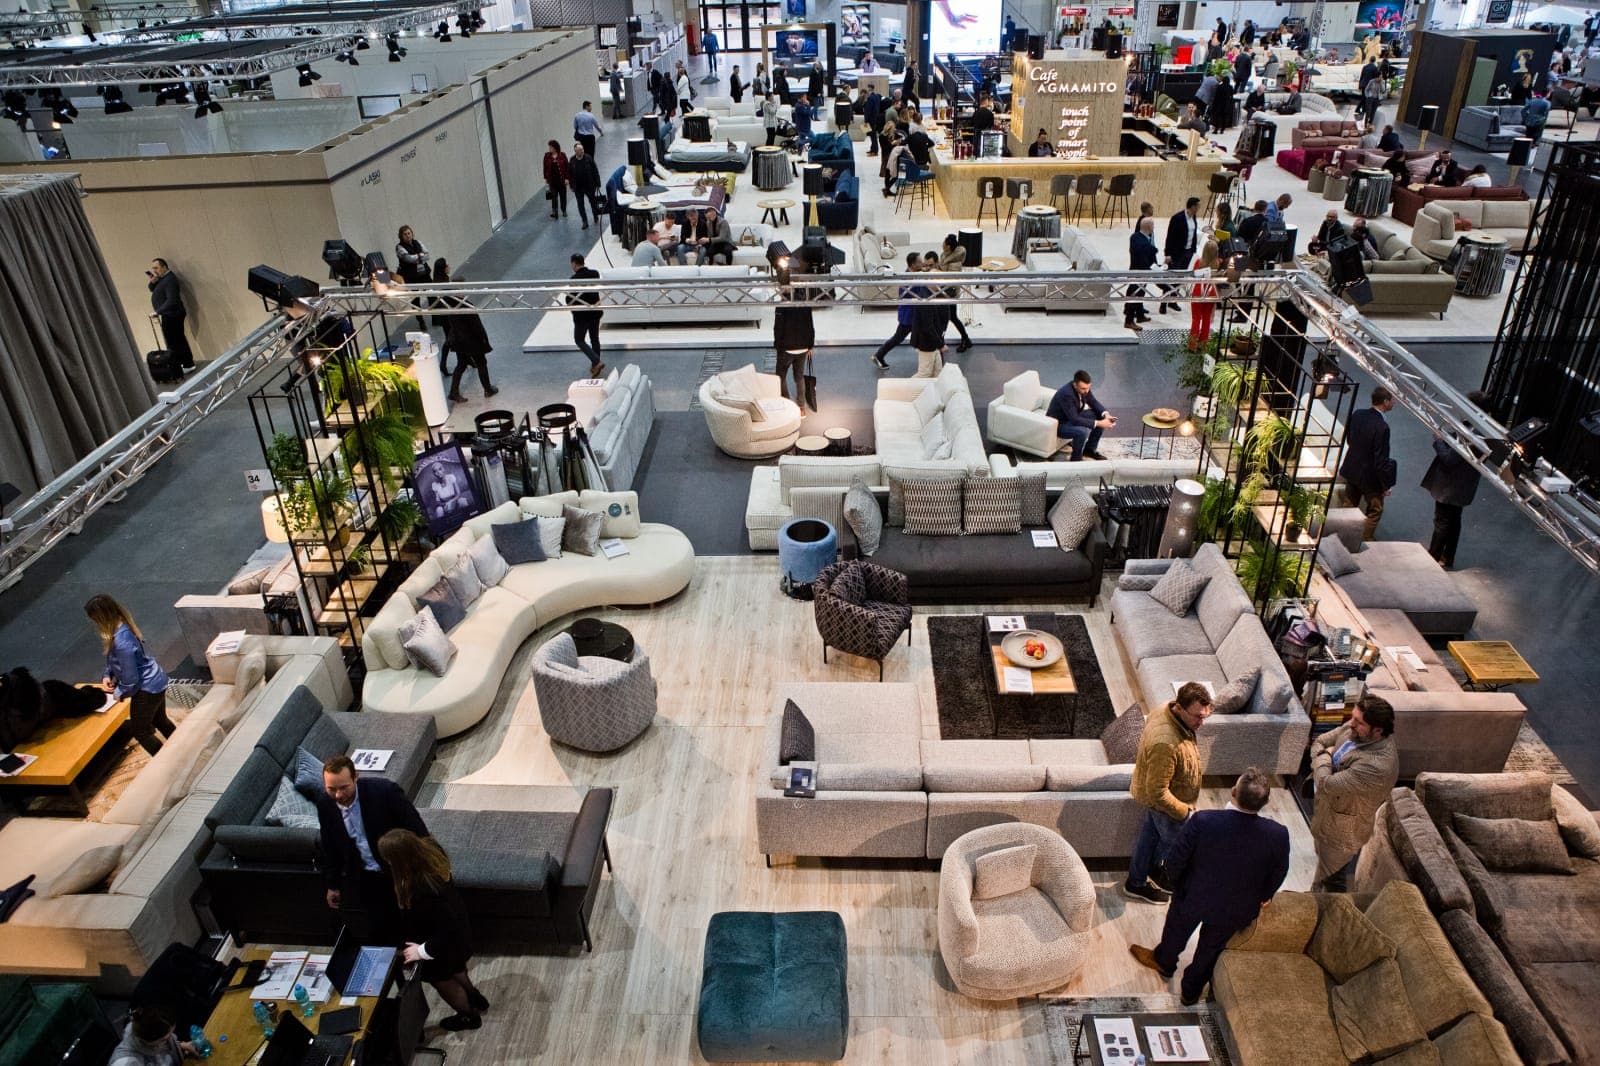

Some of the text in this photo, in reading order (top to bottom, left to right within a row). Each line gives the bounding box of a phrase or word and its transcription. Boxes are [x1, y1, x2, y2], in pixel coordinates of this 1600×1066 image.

[1030, 66, 1058, 83] Cafe
[1037, 82, 1117, 93] AGMAMITO
[1061, 106, 1089, 116] touch
[1058, 117, 1088, 129] point
[1068, 127, 1081, 139] of
[1057, 139, 1088, 147] smart
[247, 474, 260, 484] 34
